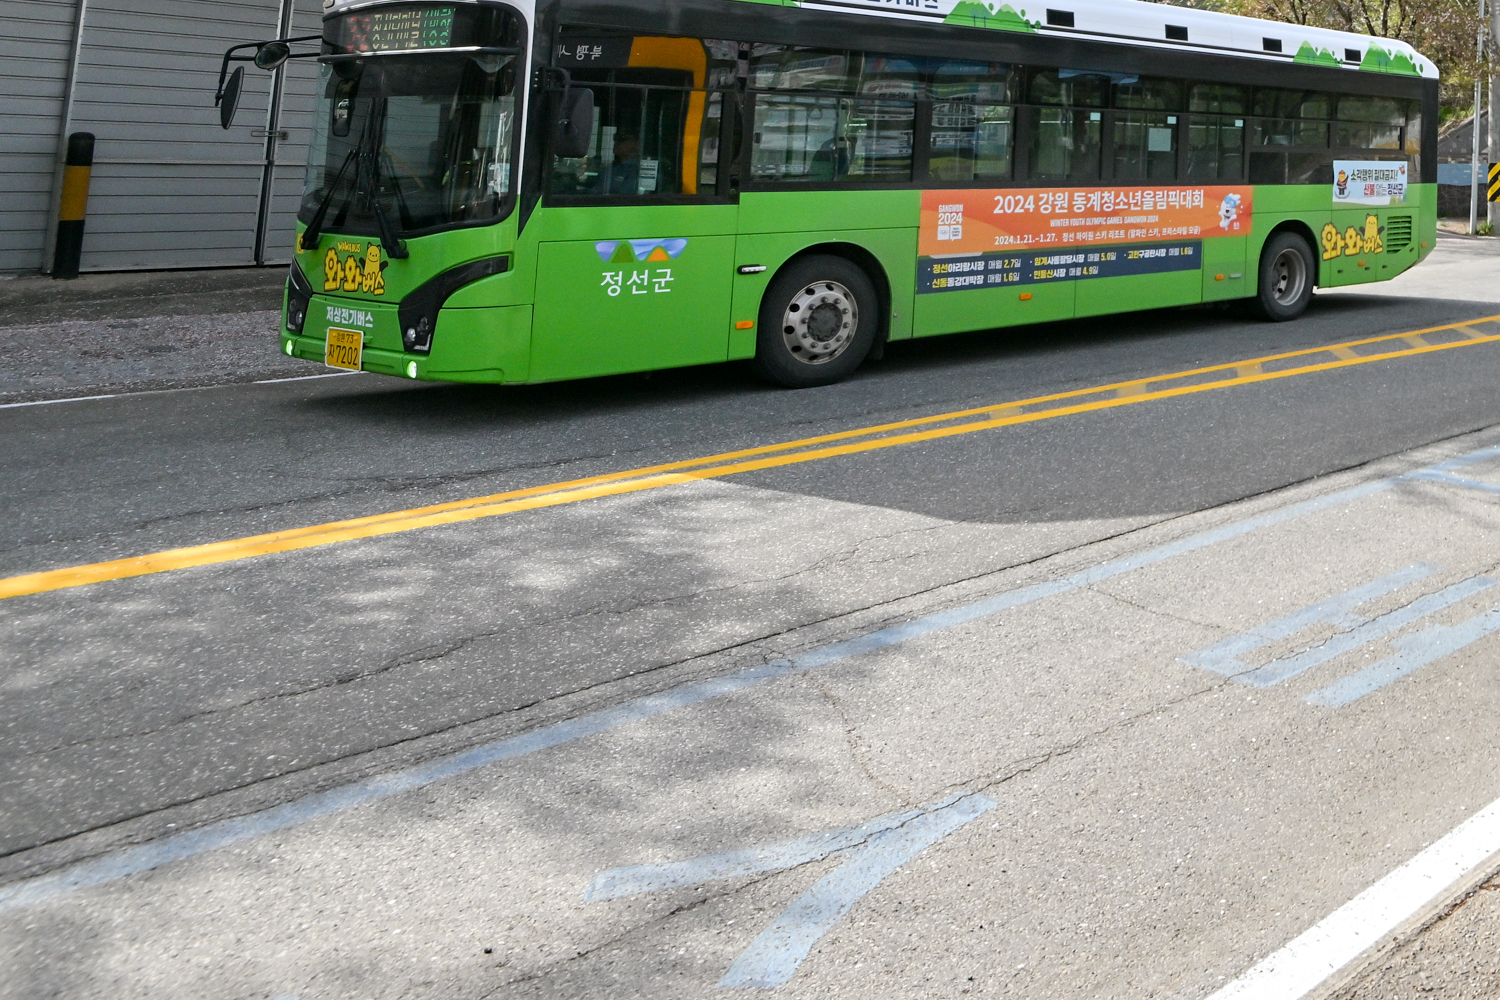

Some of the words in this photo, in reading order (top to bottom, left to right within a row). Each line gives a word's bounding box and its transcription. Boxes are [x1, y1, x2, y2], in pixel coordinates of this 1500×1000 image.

[1351, 169, 1373, 181] 소각행위
[1364, 184, 1375, 195] 산불
[1388, 184, 1403, 195] 정선군
[993, 195, 1034, 214] 2024
[1038, 192, 1068, 214] 강원
[1072, 189, 1204, 213] 동계청소년올림픽대회
[938, 204, 963, 212] GANGWON
[938, 213, 962, 224] 2024
[1050, 218, 1069, 227] WINTER
[1070, 218, 1085, 226] YOUTH
[1086, 217, 1106, 226] OLYMPIC
[1107, 216, 1122, 224] GAMES
[1124, 216, 1146, 224] GANGWON
[1147, 215, 1158, 223] 2024
[1062, 232, 1074, 242] 정선
[1076, 230, 1094, 241] 하이원
[1095, 230, 1107, 239] 스키
[1109, 230, 1125, 239] 리조트
[1322, 222, 1383, 260] 와와버스
[324, 247, 384, 295] 와와버스
[933, 261, 985, 274] 정선아리랑시장
[988, 260, 1002, 270] 매월
[601, 269, 674, 296] 정선군
[988, 274, 1001, 283] 매월
[327, 306, 373, 328] 저상전기버스
